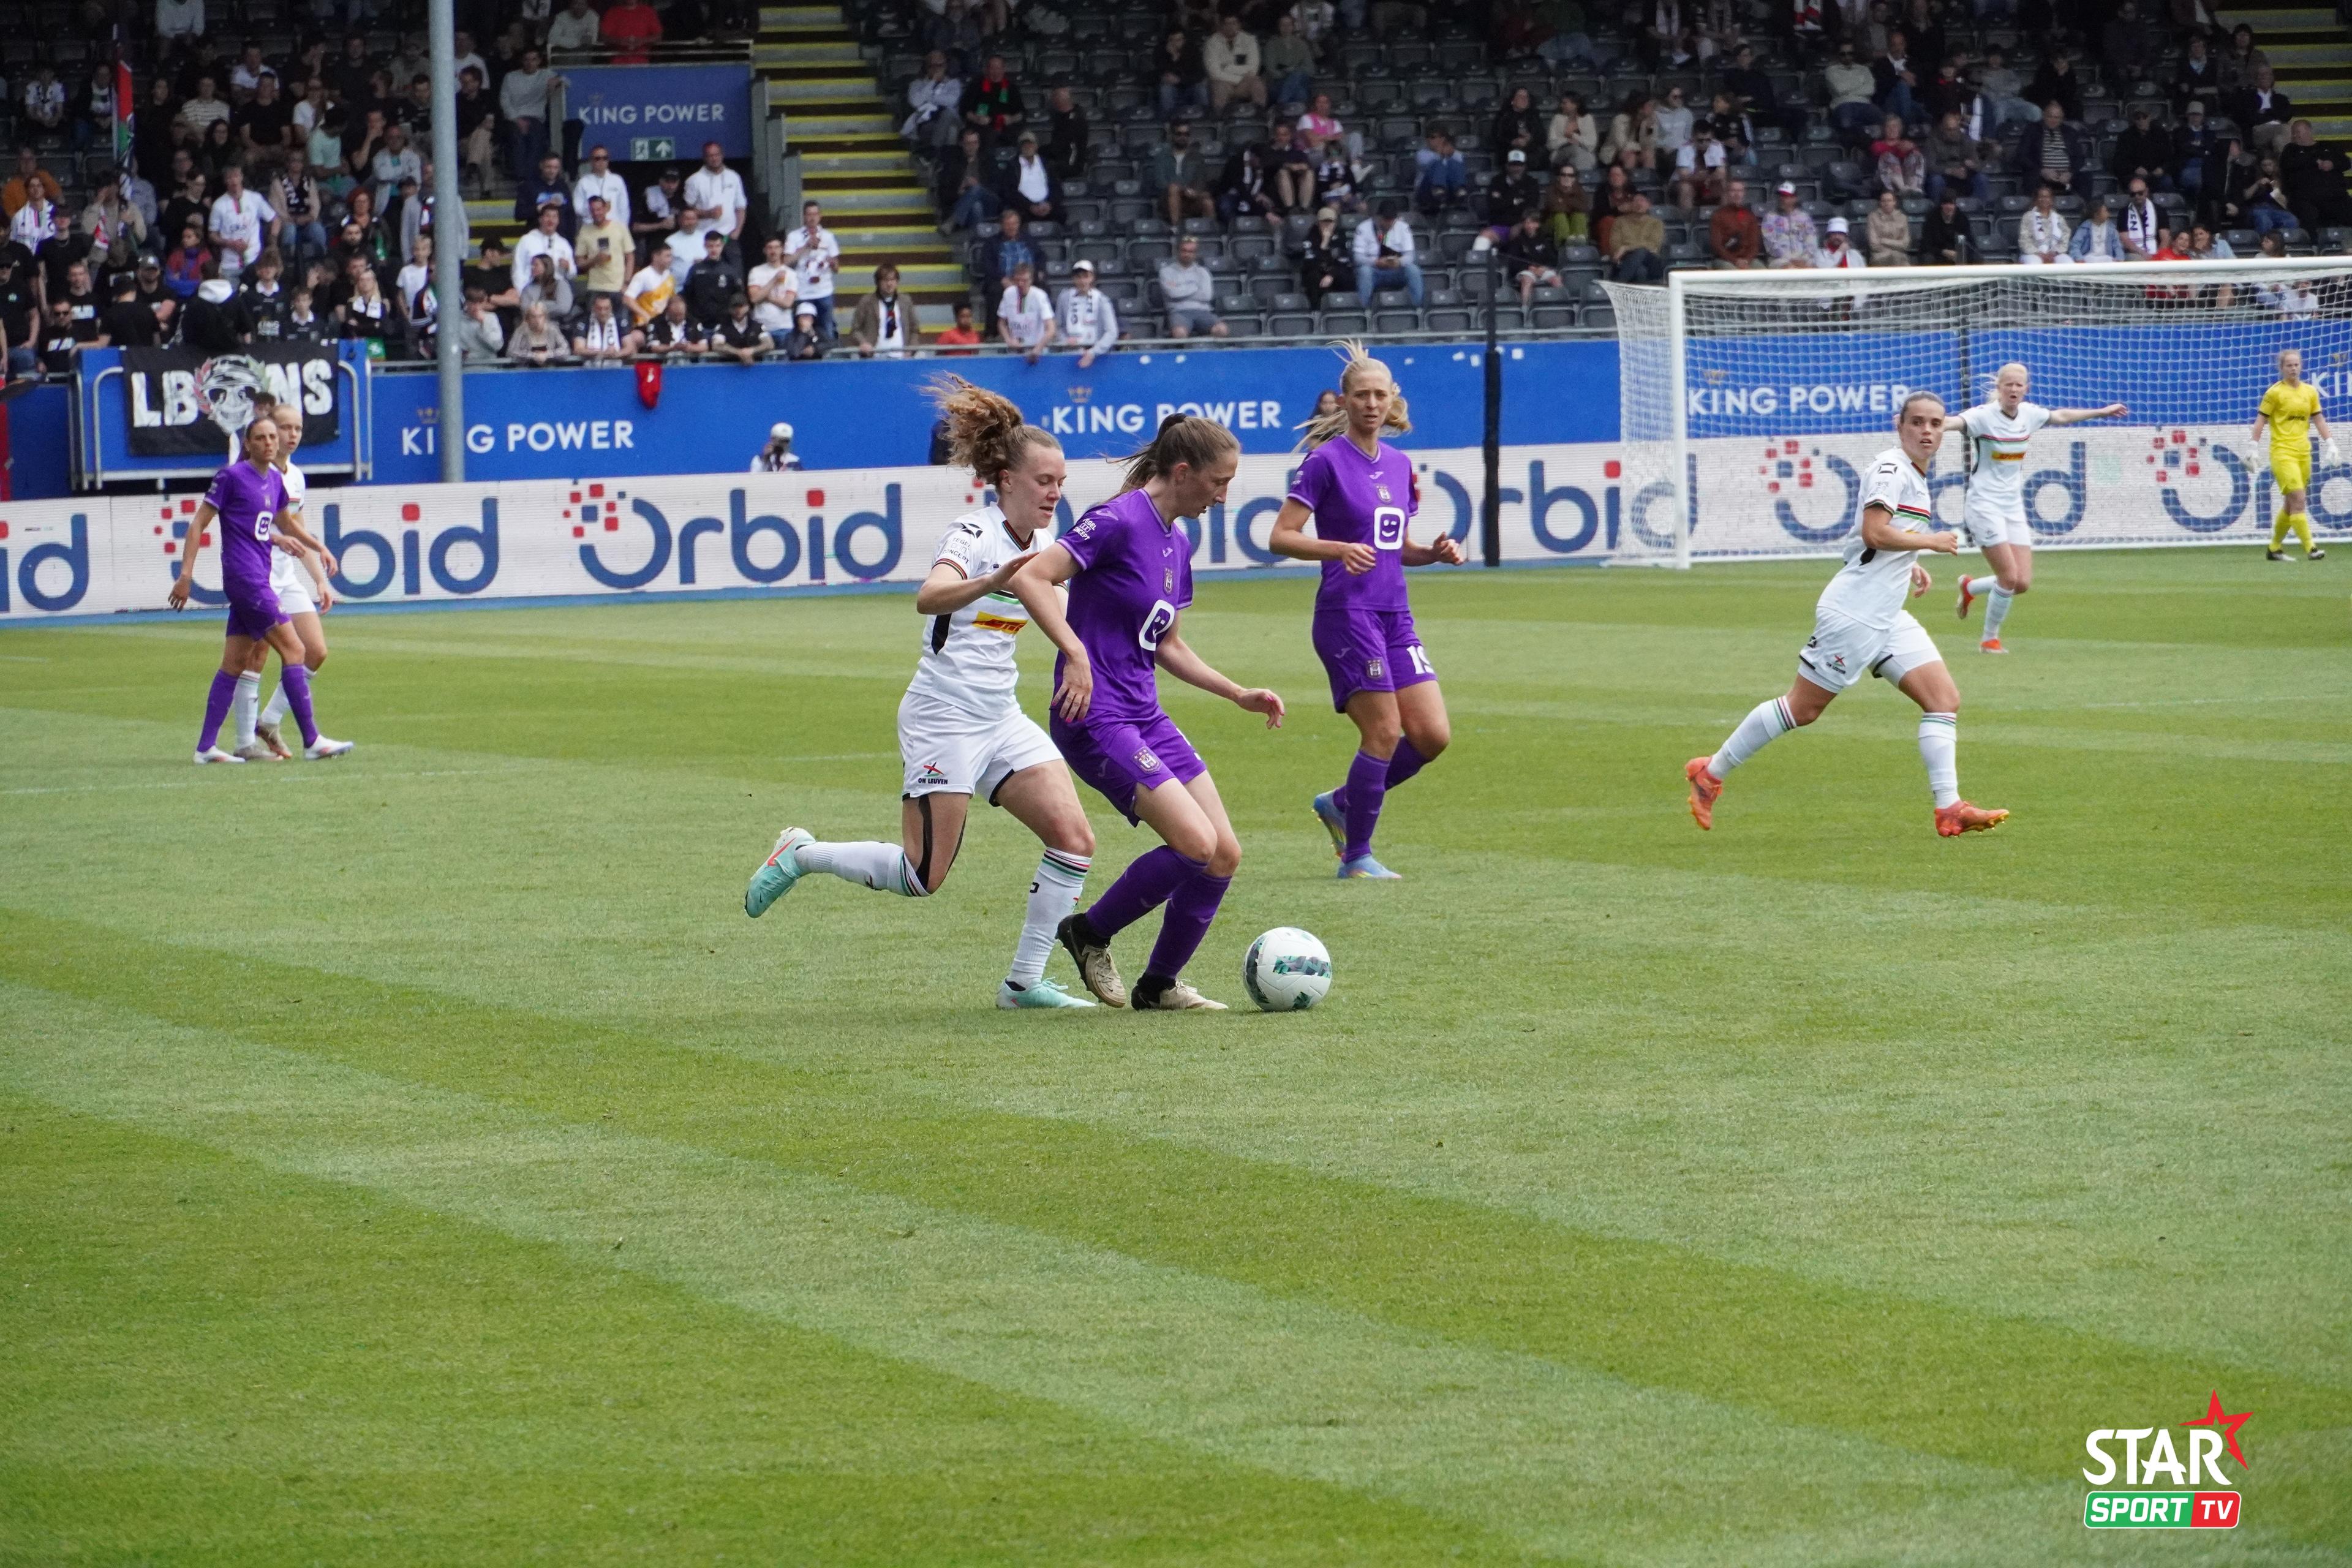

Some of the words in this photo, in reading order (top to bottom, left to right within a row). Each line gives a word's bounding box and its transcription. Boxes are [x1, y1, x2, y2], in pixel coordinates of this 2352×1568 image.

[579, 105, 637, 124] KING
[645, 104, 724, 123] POWER
[2312, 372, 2352, 397] KI
[1688, 388, 1777, 415] KING
[1790, 385, 1909, 414] POWER
[1052, 404, 1145, 434] KING
[402, 423, 495, 456] KIG
[507, 420, 635, 452] POWER
[563, 483, 903, 589] Orbid
